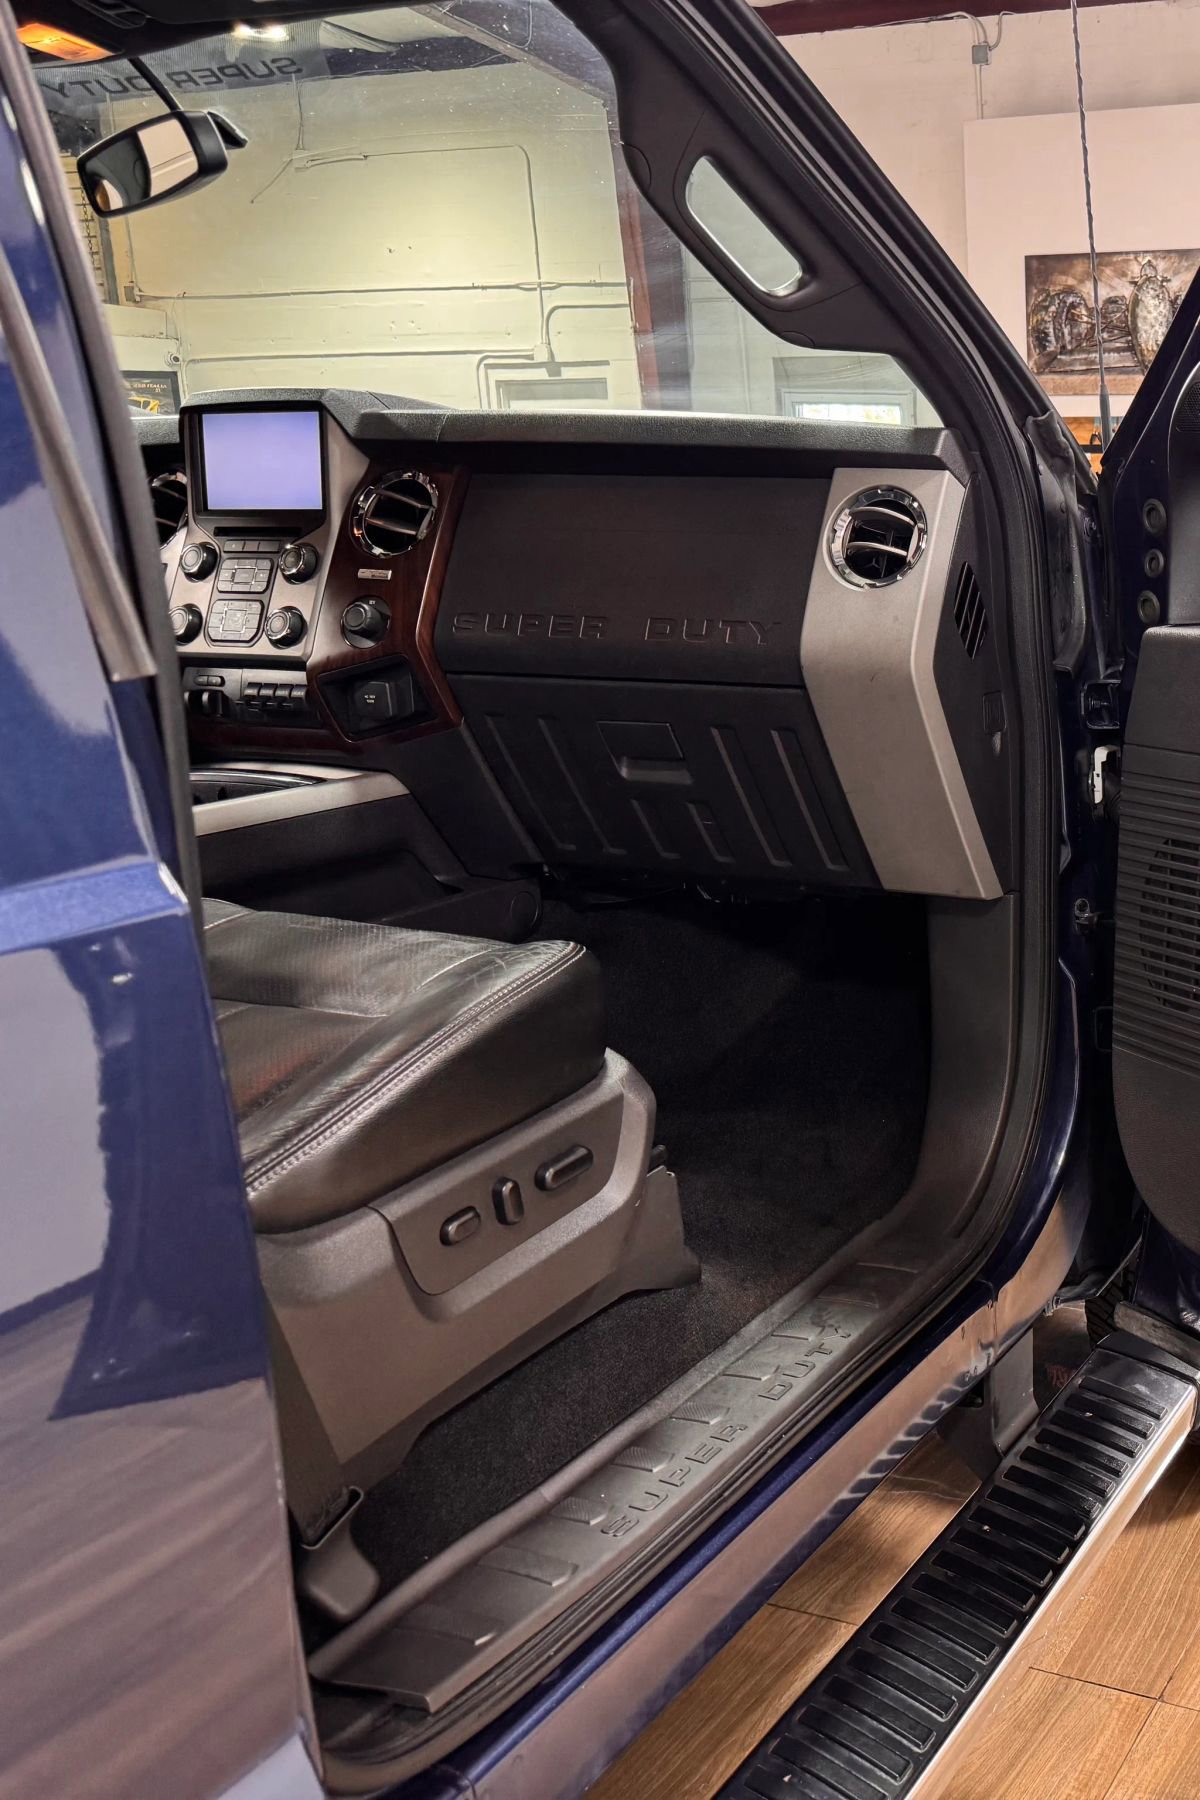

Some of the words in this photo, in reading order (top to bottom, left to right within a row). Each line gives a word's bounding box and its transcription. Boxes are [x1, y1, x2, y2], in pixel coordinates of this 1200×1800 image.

[451, 611, 609, 641] SUPER
[643, 616, 782, 647] DUTY
[600, 1422, 748, 1538] SUPER
[757, 1325, 852, 1401] DUTY
